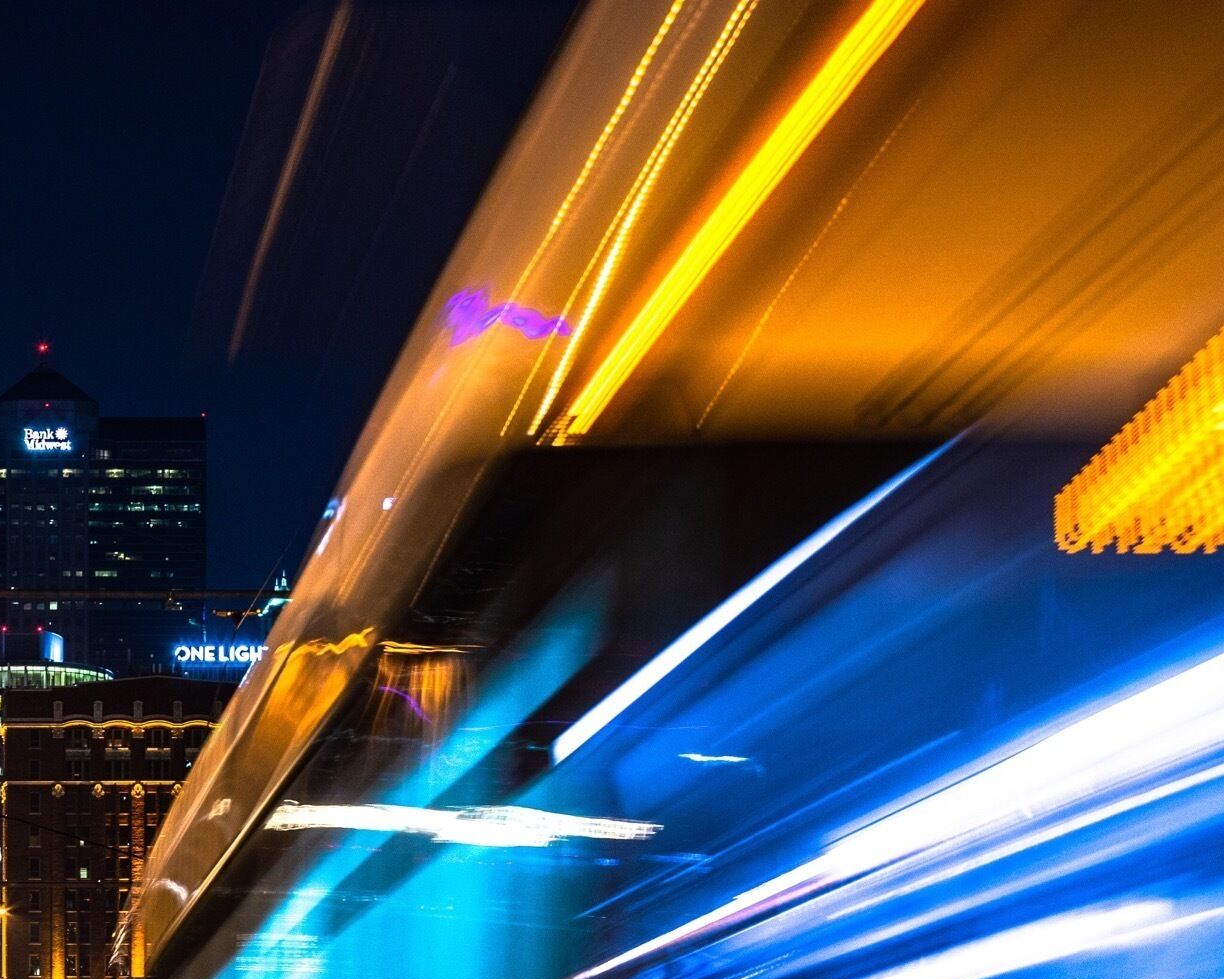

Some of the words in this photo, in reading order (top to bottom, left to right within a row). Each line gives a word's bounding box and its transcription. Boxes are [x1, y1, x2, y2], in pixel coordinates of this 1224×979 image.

[24, 428, 55, 440] Bank
[24, 439, 72, 451] Midwest
[175, 645, 216, 662] ONE
